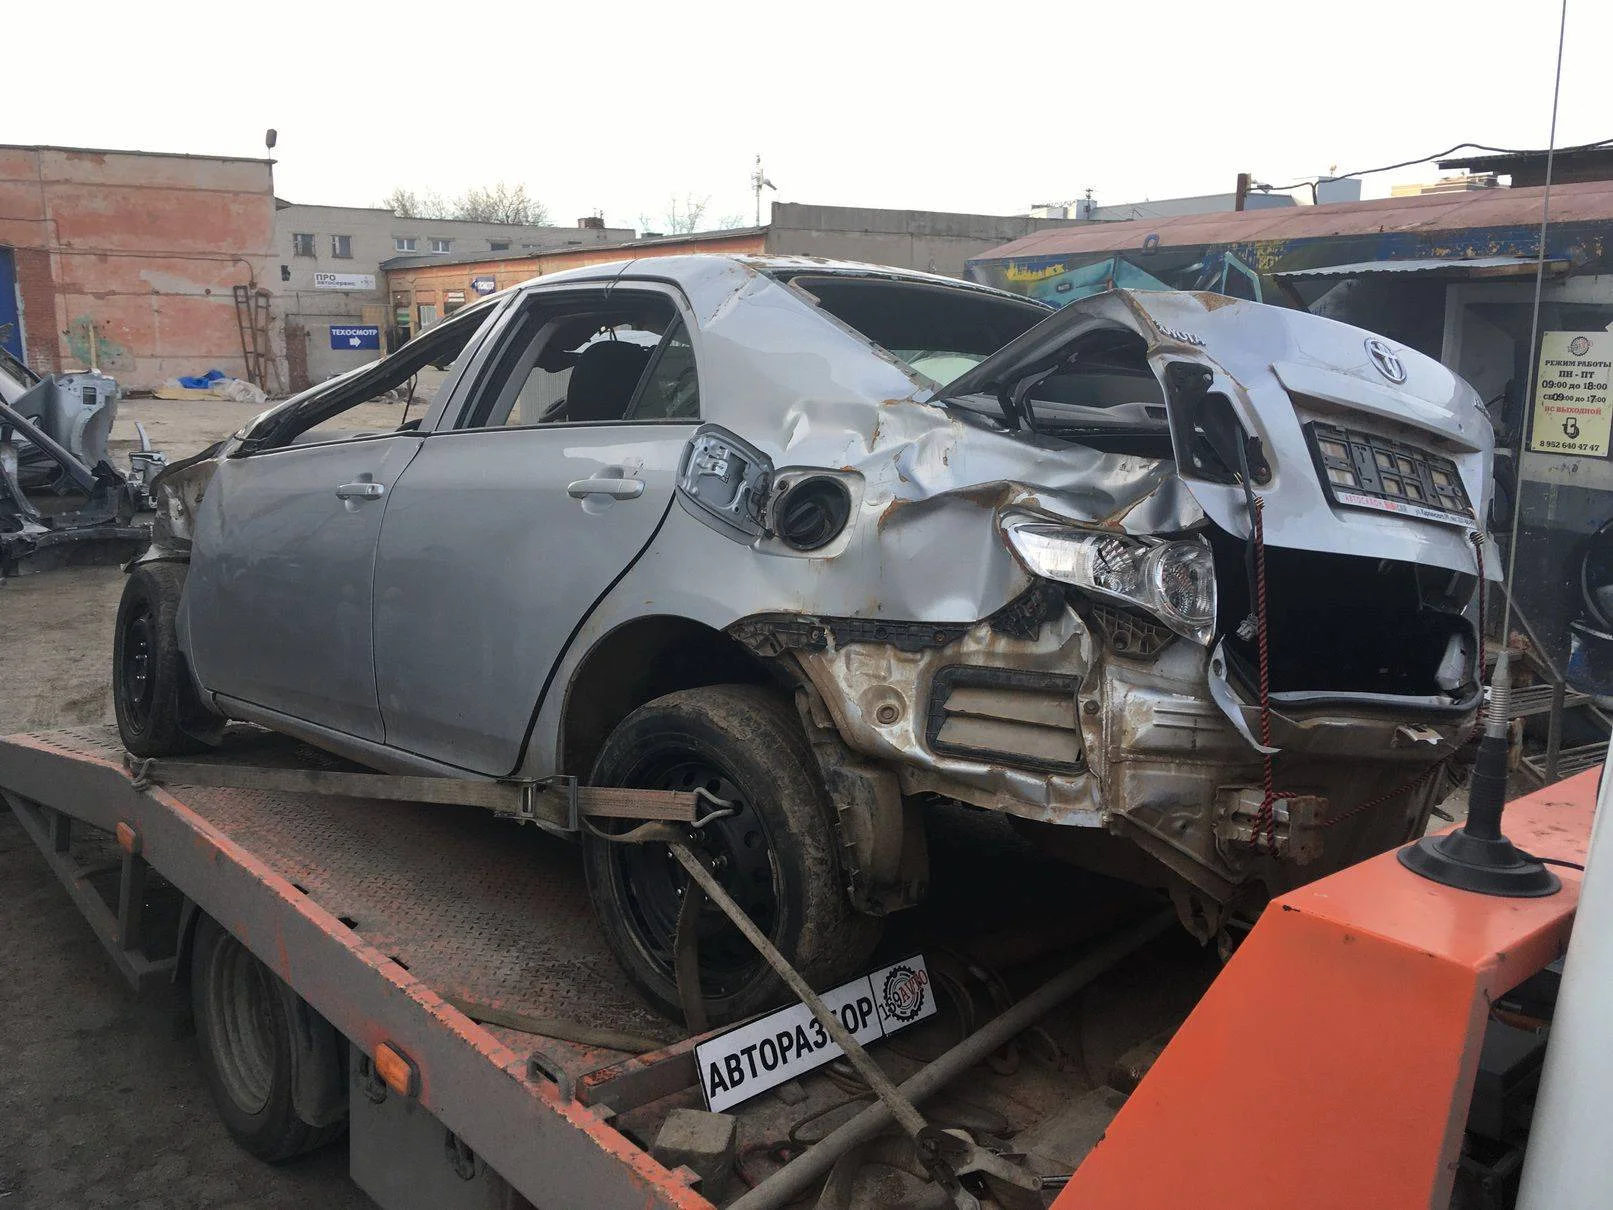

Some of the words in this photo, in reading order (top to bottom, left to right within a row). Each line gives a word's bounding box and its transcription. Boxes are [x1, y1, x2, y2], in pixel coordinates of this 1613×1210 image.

[1542, 380, 1567, 389] 09:00
[1584, 382, 1608, 390] 18:00
[1587, 395, 1607, 403] 17:00
[1556, 406, 1602, 415] ВЫХОДНОЙ
[709, 996, 874, 1099] АВТОРАЗОР
